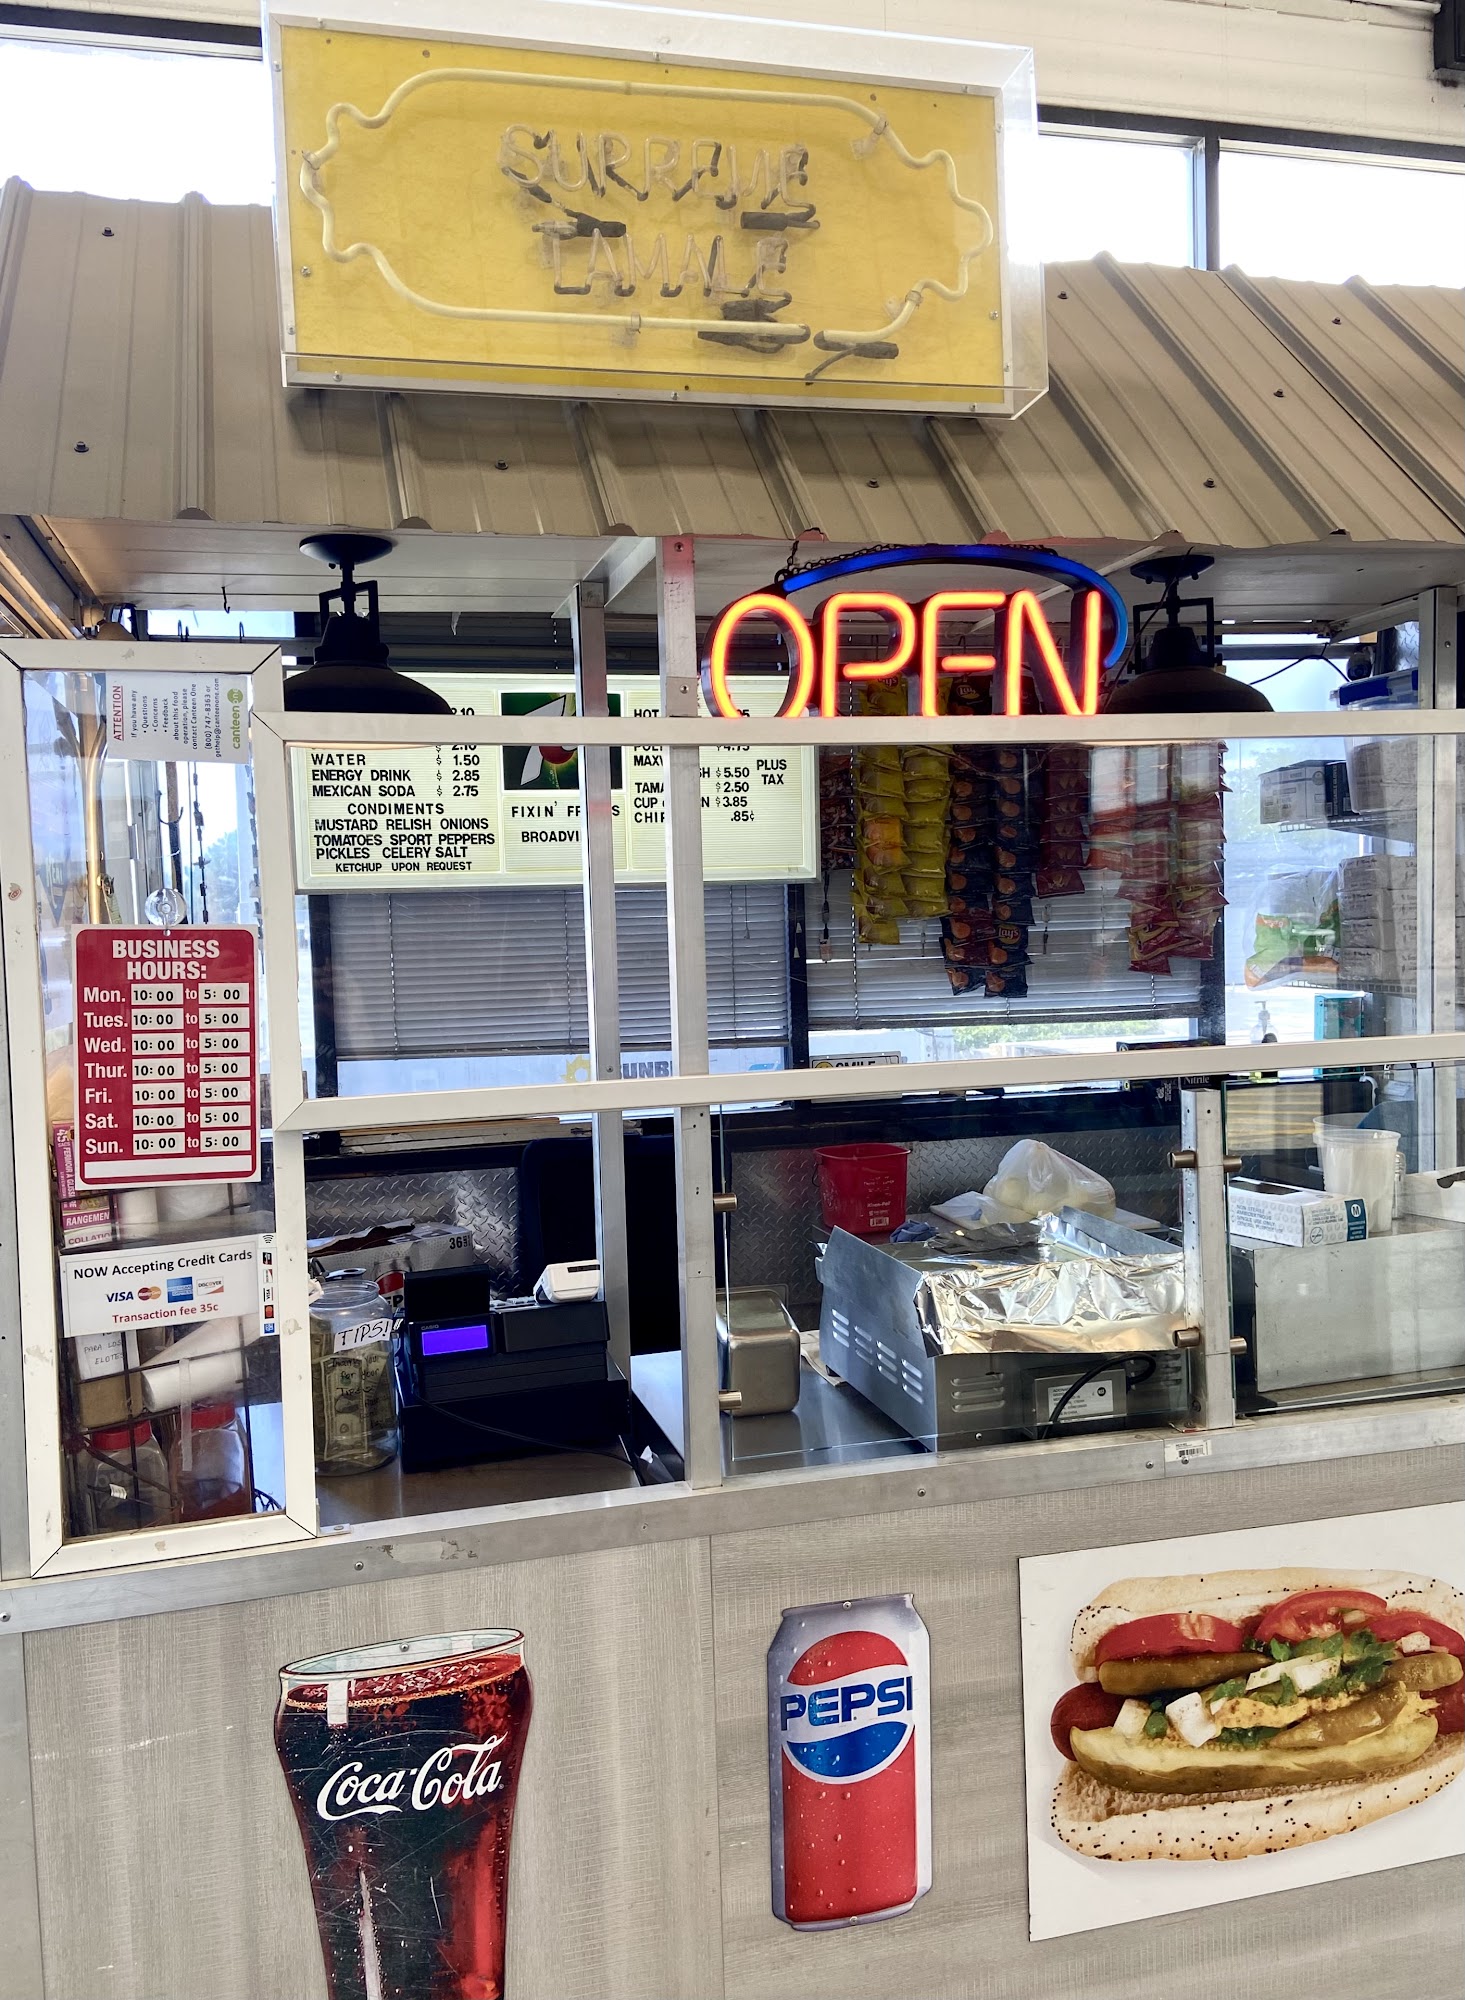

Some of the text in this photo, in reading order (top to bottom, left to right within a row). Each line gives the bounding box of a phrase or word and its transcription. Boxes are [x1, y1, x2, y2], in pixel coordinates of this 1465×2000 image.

[501, 122, 814, 209] SUPREME
[536, 226, 792, 297] TAMALE
[709, 589, 1101, 718] OPEN
[205, 685, 211, 693] or
[112, 686, 122, 741] ATTENTION
[230, 705, 241, 749] canteen
[311, 753, 480, 766] WATER $ 1.50
[756, 759, 787, 770] PLUS
[312, 769, 480, 781] ENERGY DRINK $ 2.85
[716, 767, 750, 778] $5.50
[761, 774, 784, 785] TAX
[312, 785, 479, 797] MEXICAN SODA $ 2.75
[715, 782, 749, 793] $2.50
[347, 803, 444, 815] CONDIMENTS
[511, 801, 558, 818] FIXIN'
[634, 797, 658, 808] CUP
[715, 796, 748, 807] $3.85
[315, 818, 489, 831] MUSTARD RELISH ONIONS
[314, 833, 495, 847] TOMATOES SPORT PEPPERS
[316, 846, 468, 860] PICKLES CELERY SALT
[336, 861, 472, 872] KETCHUP UPON REQUEST
[112, 939, 220, 959] BUSINESS
[127, 961, 207, 981] HOURS:
[83, 986, 126, 1003] Mon.
[184, 987, 198, 1000] to
[83, 1012, 128, 1028] Tues.
[185, 1012, 198, 1025] to
[84, 1037, 127, 1053] Wed.
[185, 1036, 198, 1049] to
[84, 1062, 128, 1079] Thur.
[186, 1061, 199, 1074] to
[84, 1087, 112, 1104] Fri.
[186, 1086, 199, 1099] to
[84, 1113, 119, 1129] Sat.
[186, 1111, 199, 1124] to
[85, 1138, 124, 1155] Sun.
[186, 1136, 199, 1148] to
[67, 1179, 77, 1208] GLISSIRE
[66, 1211, 110, 1227] RANGEMEN
[449, 1236, 463, 1250] 36
[73, 1250, 253, 1279] NOW Accepting Credit Cards
[106, 1291, 134, 1303] VISA
[112, 1303, 219, 1324] Transaction fee 35c
[338, 1320, 390, 1346] TIPS!
[83, 1339, 122, 1354] PARA LOS
[780, 1675, 913, 1732] PEPSI
[316, 1731, 508, 1821] Coca-Cola
